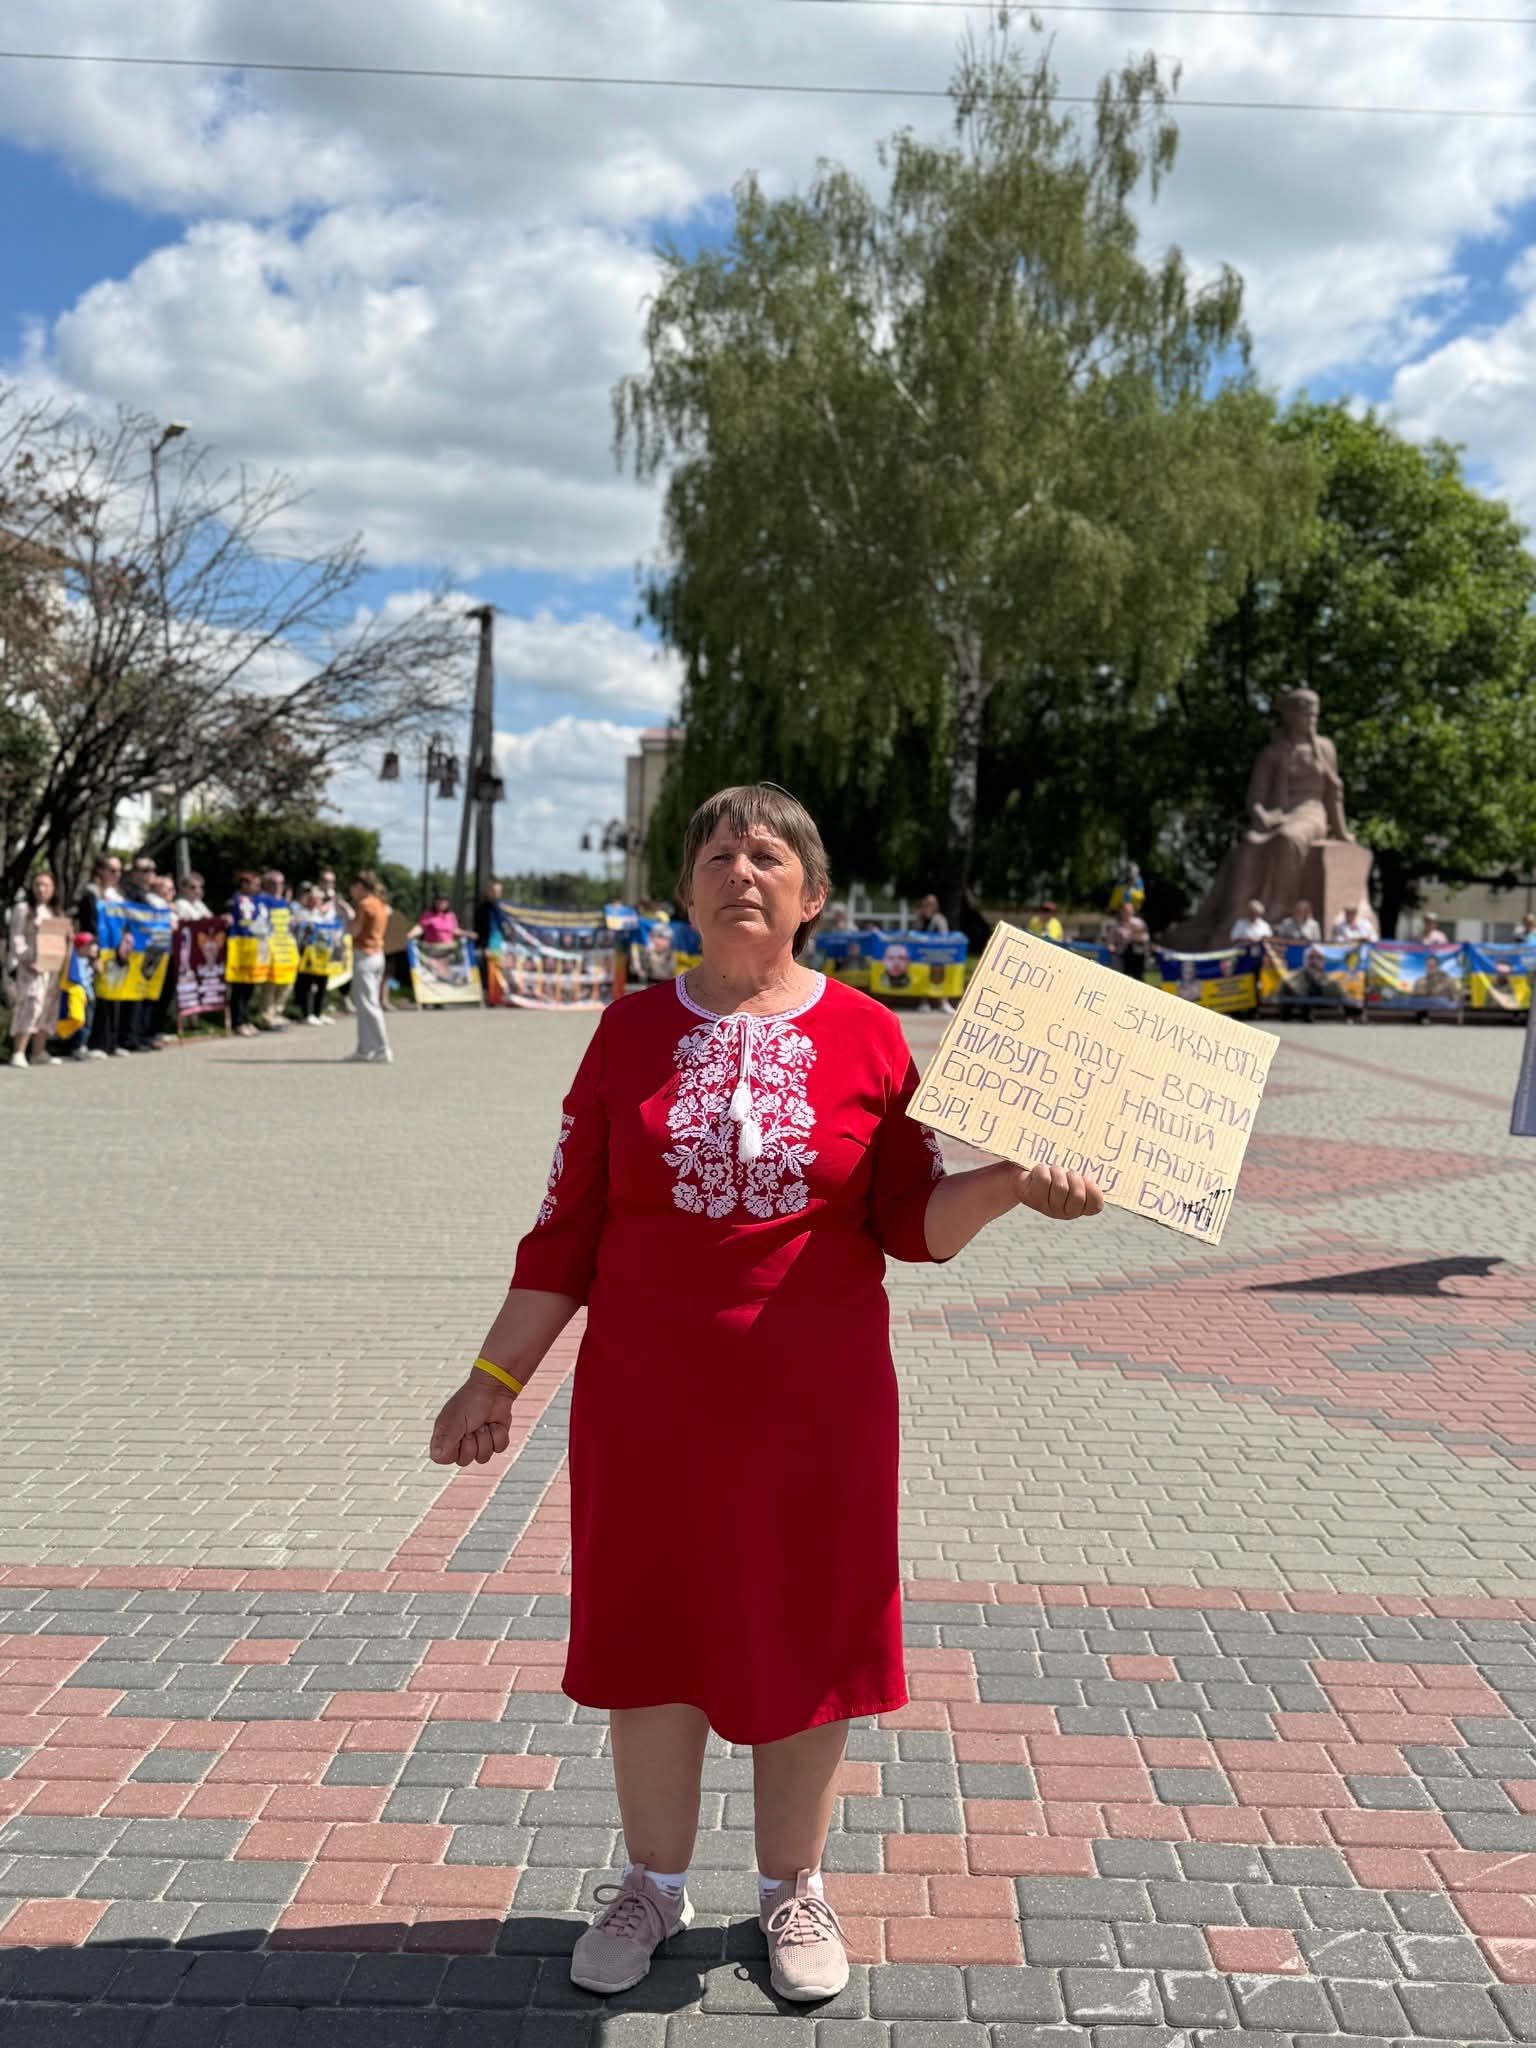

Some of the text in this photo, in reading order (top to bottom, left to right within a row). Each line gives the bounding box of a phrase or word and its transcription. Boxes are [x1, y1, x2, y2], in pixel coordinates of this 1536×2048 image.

[952, 1018, 1215, 1150] ЖИВУТЬ У НАШІЙ
[973, 985, 1025, 1031] БЕЗ
[1046, 1023, 1125, 1085] СЛІДУ
[1161, 1073, 1251, 1132] ВОНИ
[1074, 985, 1107, 1015] НЕ
[1113, 1005, 1265, 1084] ЗНИКАЮТЬ
[919, 1085, 974, 1131] ВІРІ,
[972, 1110, 999, 1143] У
[1014, 1127, 1123, 1193] НАШОМУ
[941, 1050, 1228, 1191] БОРОТЬБІ, У НАШІЙ
